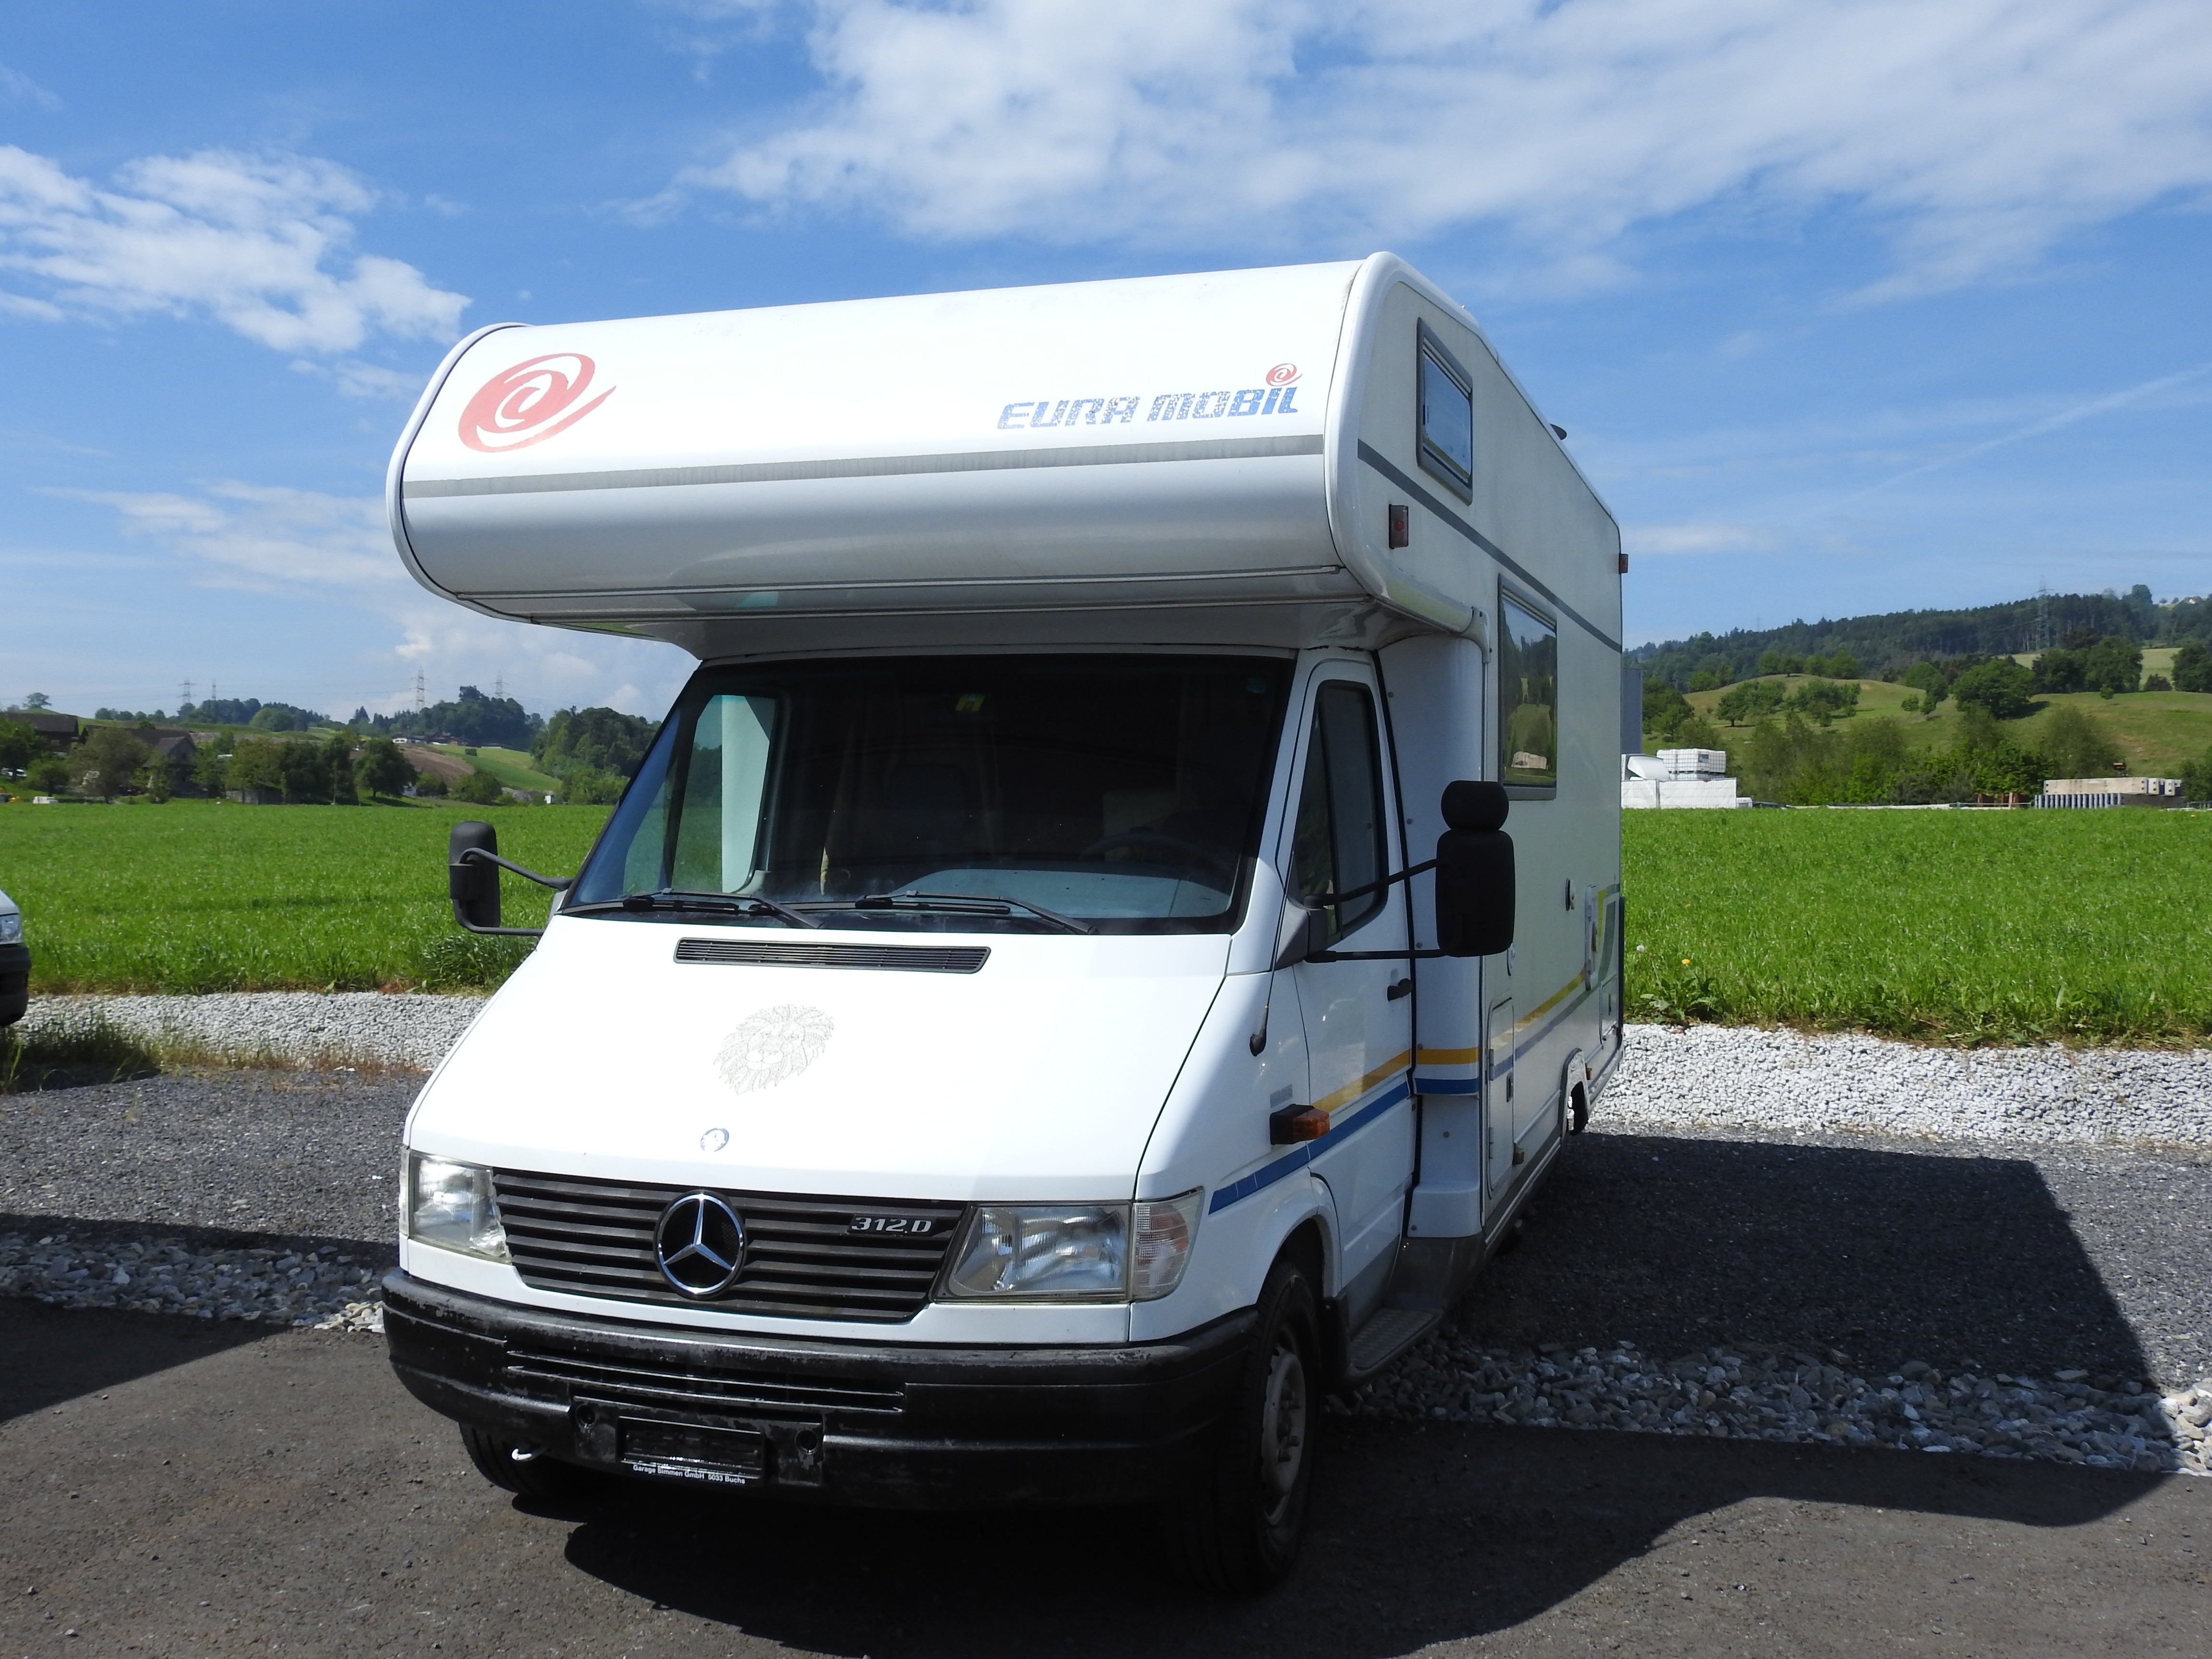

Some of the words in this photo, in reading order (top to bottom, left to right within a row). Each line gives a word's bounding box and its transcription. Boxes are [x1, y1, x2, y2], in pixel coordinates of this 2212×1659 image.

[997, 396, 1141, 430] EURA
[1147, 386, 1298, 422] MOBIL
[633, 1465, 656, 1474] Garage
[685, 1471, 705, 1479] GmbH
[725, 1476, 745, 1484] Buchs
